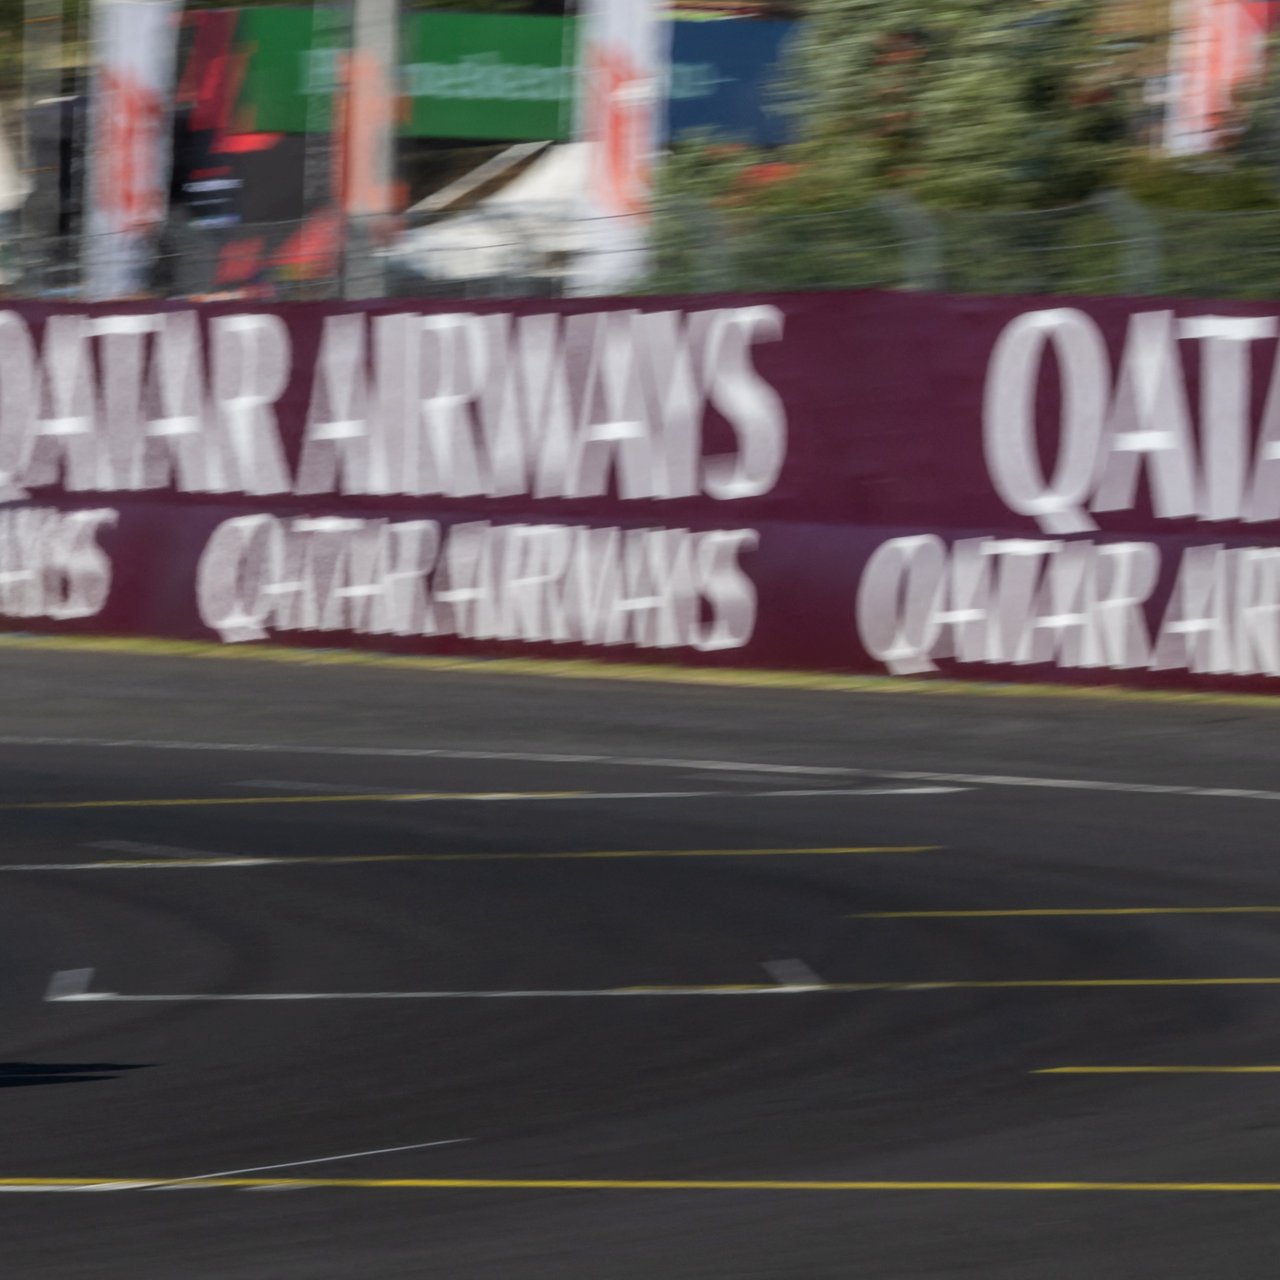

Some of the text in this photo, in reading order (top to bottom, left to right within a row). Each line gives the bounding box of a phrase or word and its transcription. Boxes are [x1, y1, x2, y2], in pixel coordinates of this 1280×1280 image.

[296, 304, 787, 501] AIRWAYS
[196, 513, 760, 651] QATAR AIRWAYS
[857, 533, 1159, 675] QATAR
